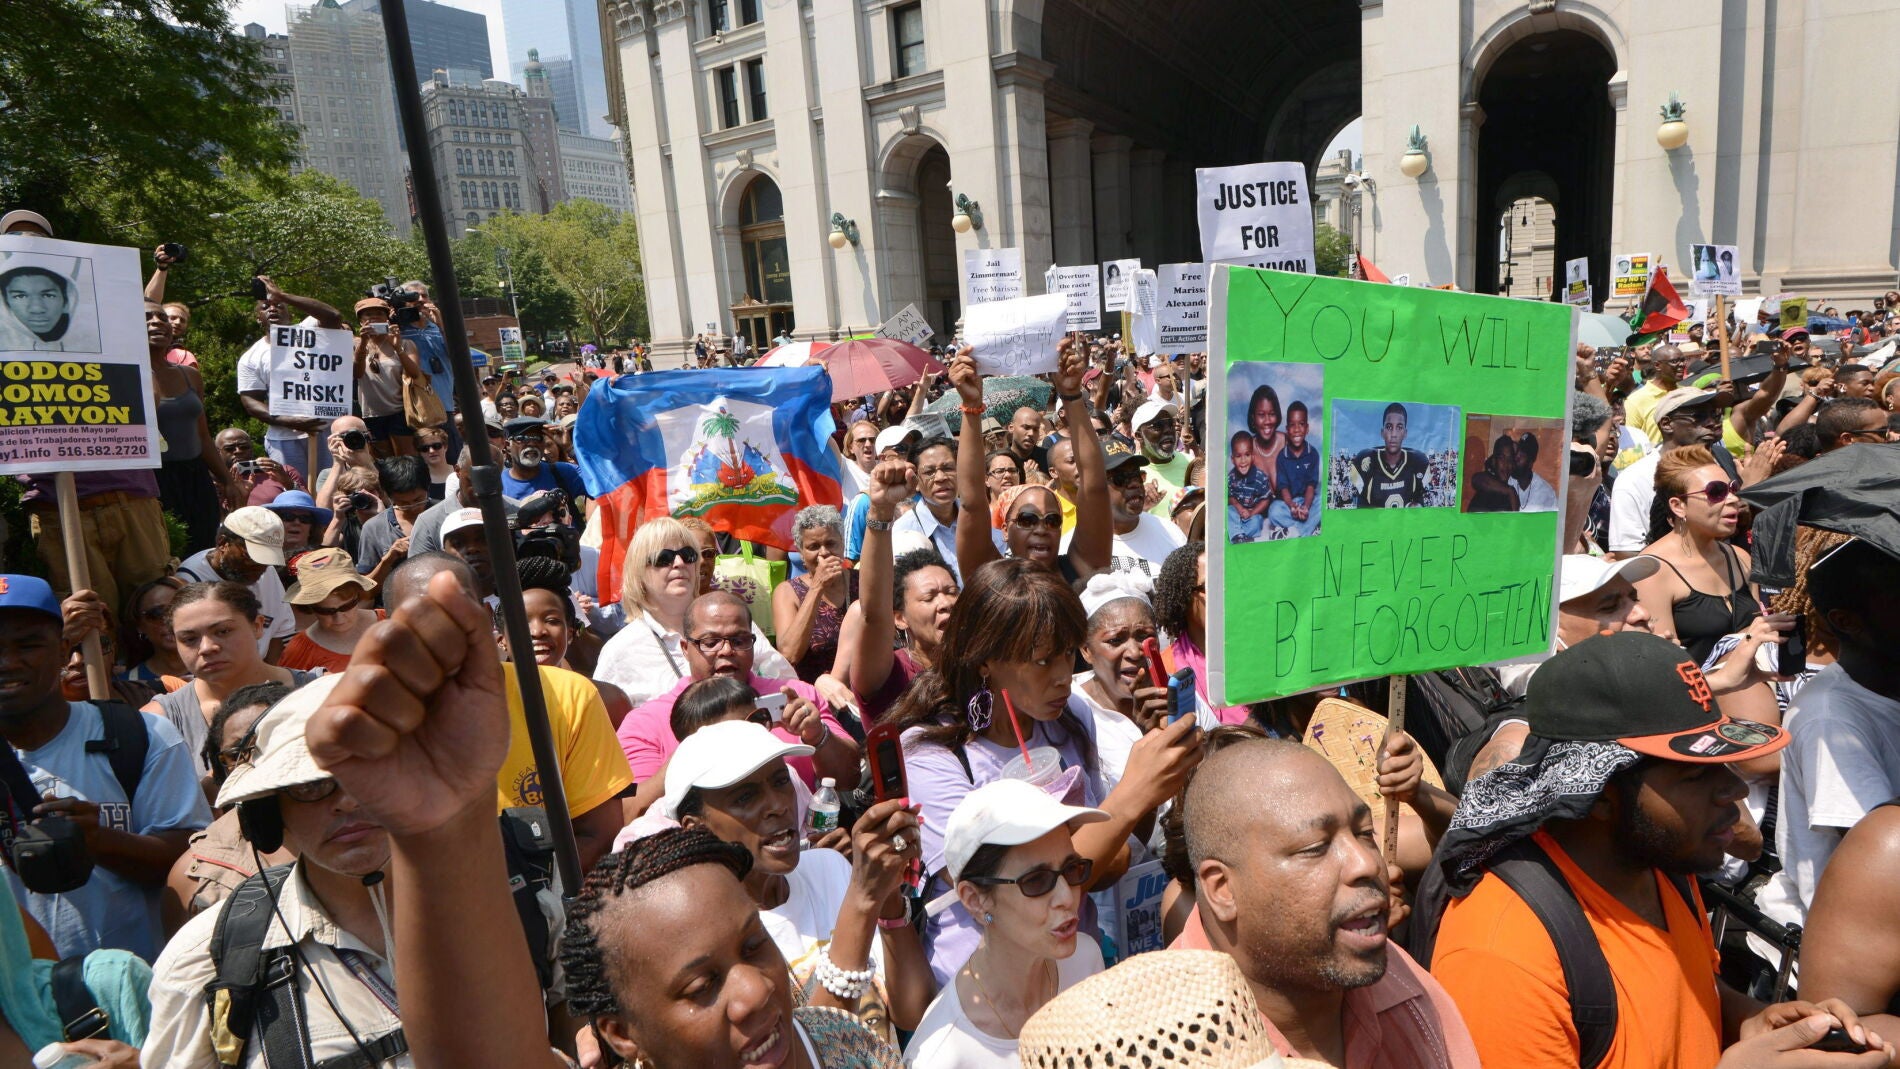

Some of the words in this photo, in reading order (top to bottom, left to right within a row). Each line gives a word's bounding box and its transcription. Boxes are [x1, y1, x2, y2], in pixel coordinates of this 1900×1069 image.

[1213, 180, 1299, 211] JUSTICE
[1241, 225, 1279, 250] FOR
[970, 270, 1018, 279] Zimmerman!
[1181, 273, 1202, 281] Free
[990, 285, 1018, 293] Marissa
[1181, 311, 1200, 319] Jail
[1255, 270, 1395, 363] YOU
[1438, 312, 1541, 371] WILL
[277, 327, 316, 348] END
[293, 350, 343, 372] STOP
[303, 371, 310, 382] &
[0, 383, 111, 403] OMOS
[283, 381, 344, 403] FRISK!
[6, 438, 18, 446] de
[19, 437, 33, 446] los
[35, 436, 91, 446] Trabajadores
[99, 435, 147, 444] Inmigrantes
[32, 427, 67, 435] Primero
[68, 426, 79, 434] de
[81, 426, 104, 435] Mayo
[58, 445, 147, 457] 516.582.2720
[1322, 534, 1468, 598] NEVER
[1275, 596, 1330, 678] BE
[1352, 575, 1553, 669] FORGOTTEN
